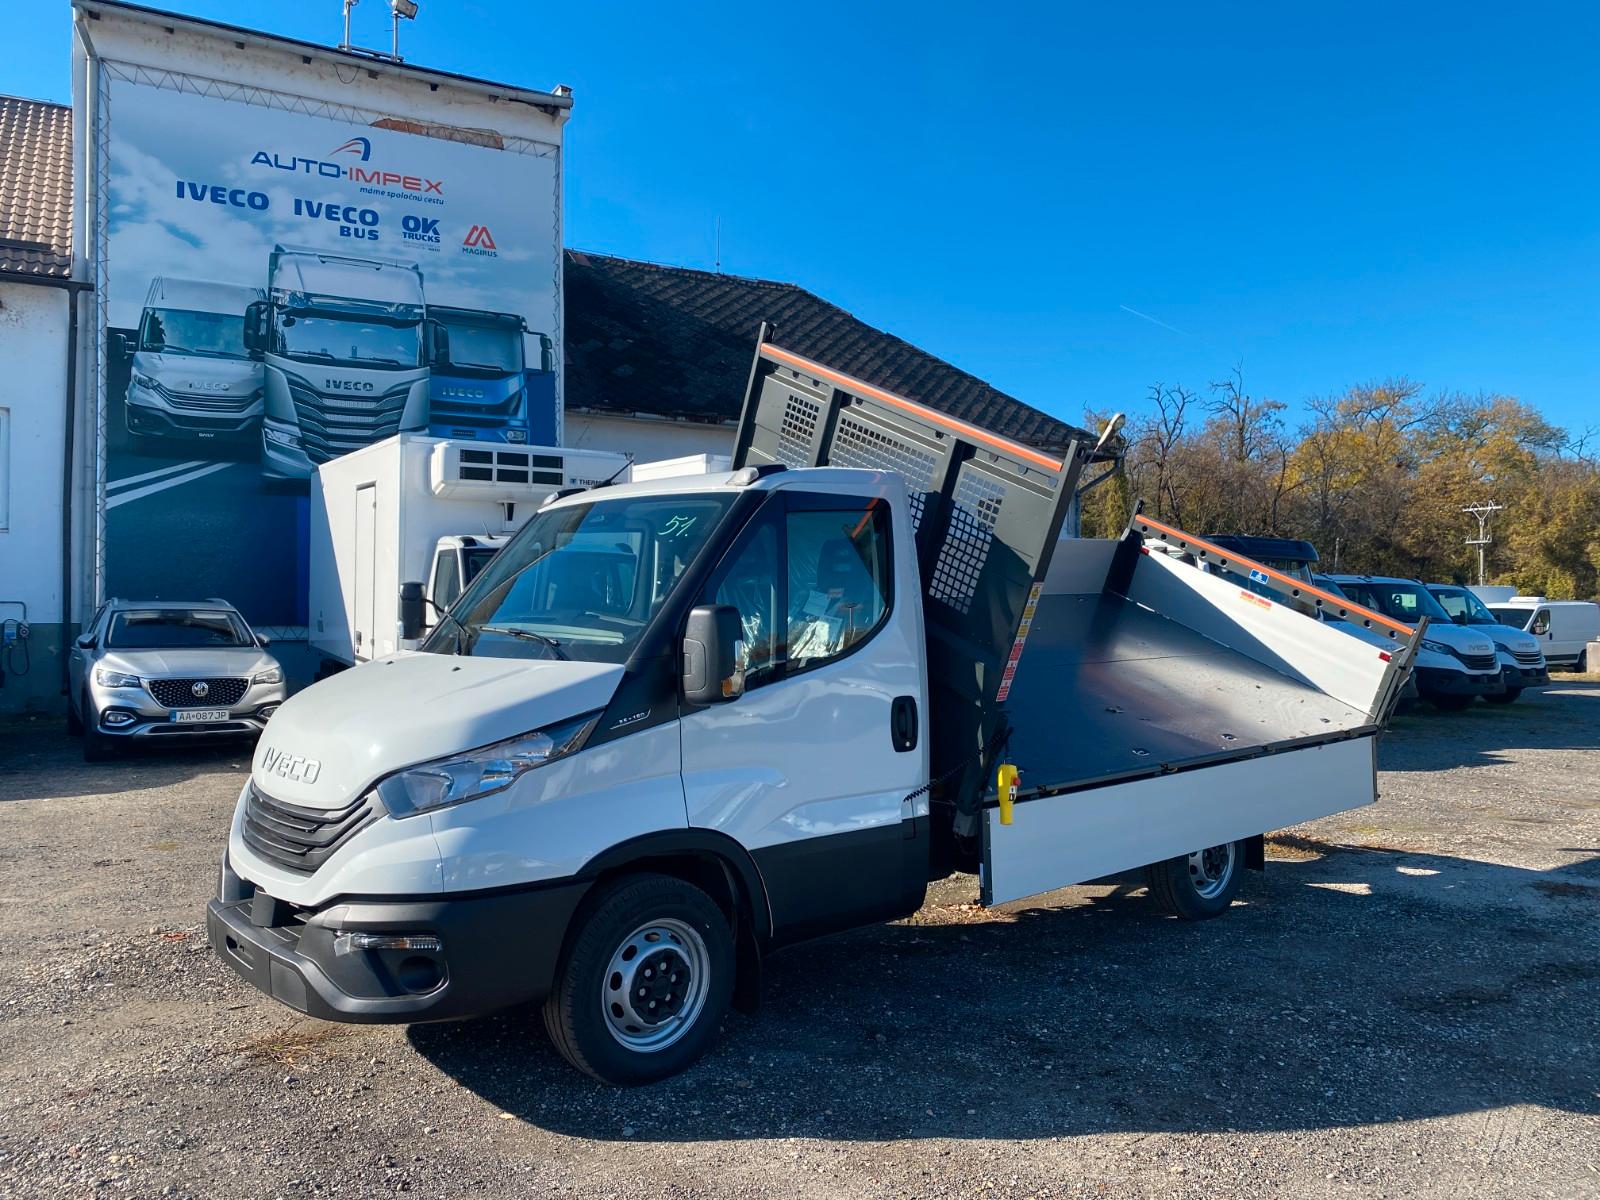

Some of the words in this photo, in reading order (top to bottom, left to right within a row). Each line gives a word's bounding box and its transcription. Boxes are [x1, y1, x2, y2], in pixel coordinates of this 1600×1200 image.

[250, 151, 444, 195] AUTO-IMPEX
[176, 181, 270, 211] IVECO
[387, 190, 423, 203] spoločnú
[424, 196, 444, 206] cestu
[294, 199, 380, 227] IVECO
[402, 215, 441, 236] OK
[339, 226, 379, 241] BUS
[402, 231, 441, 244] TRUCKS
[462, 247, 498, 258] MAGIRUS
[188, 382, 230, 391] IVECO
[325, 379, 374, 392] IVECO
[442, 386, 484, 398] IVECO
[262, 747, 322, 785] IVECO
